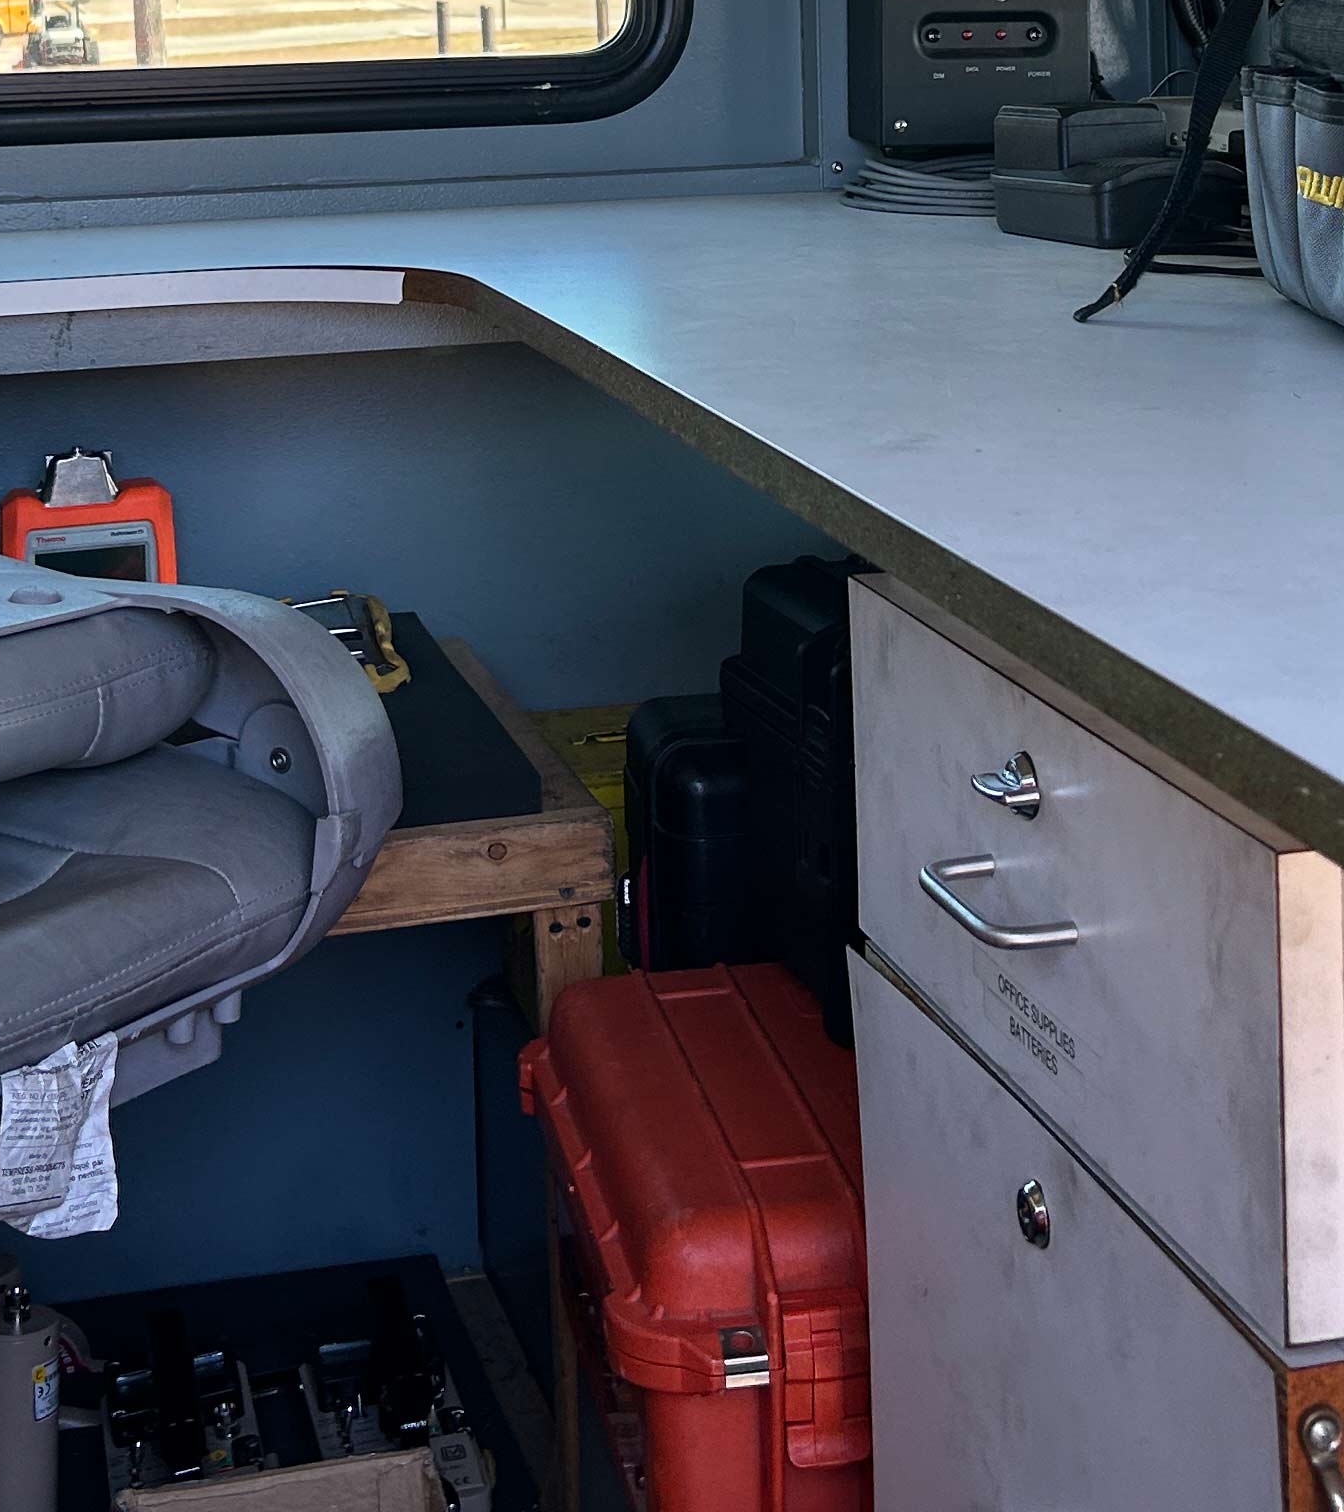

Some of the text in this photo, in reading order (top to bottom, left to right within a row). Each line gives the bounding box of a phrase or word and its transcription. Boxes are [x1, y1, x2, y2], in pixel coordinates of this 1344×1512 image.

[998, 973, 1077, 1061] OFFICE SUPPLIES
[1009, 1015, 1059, 1077] BATTERIES
